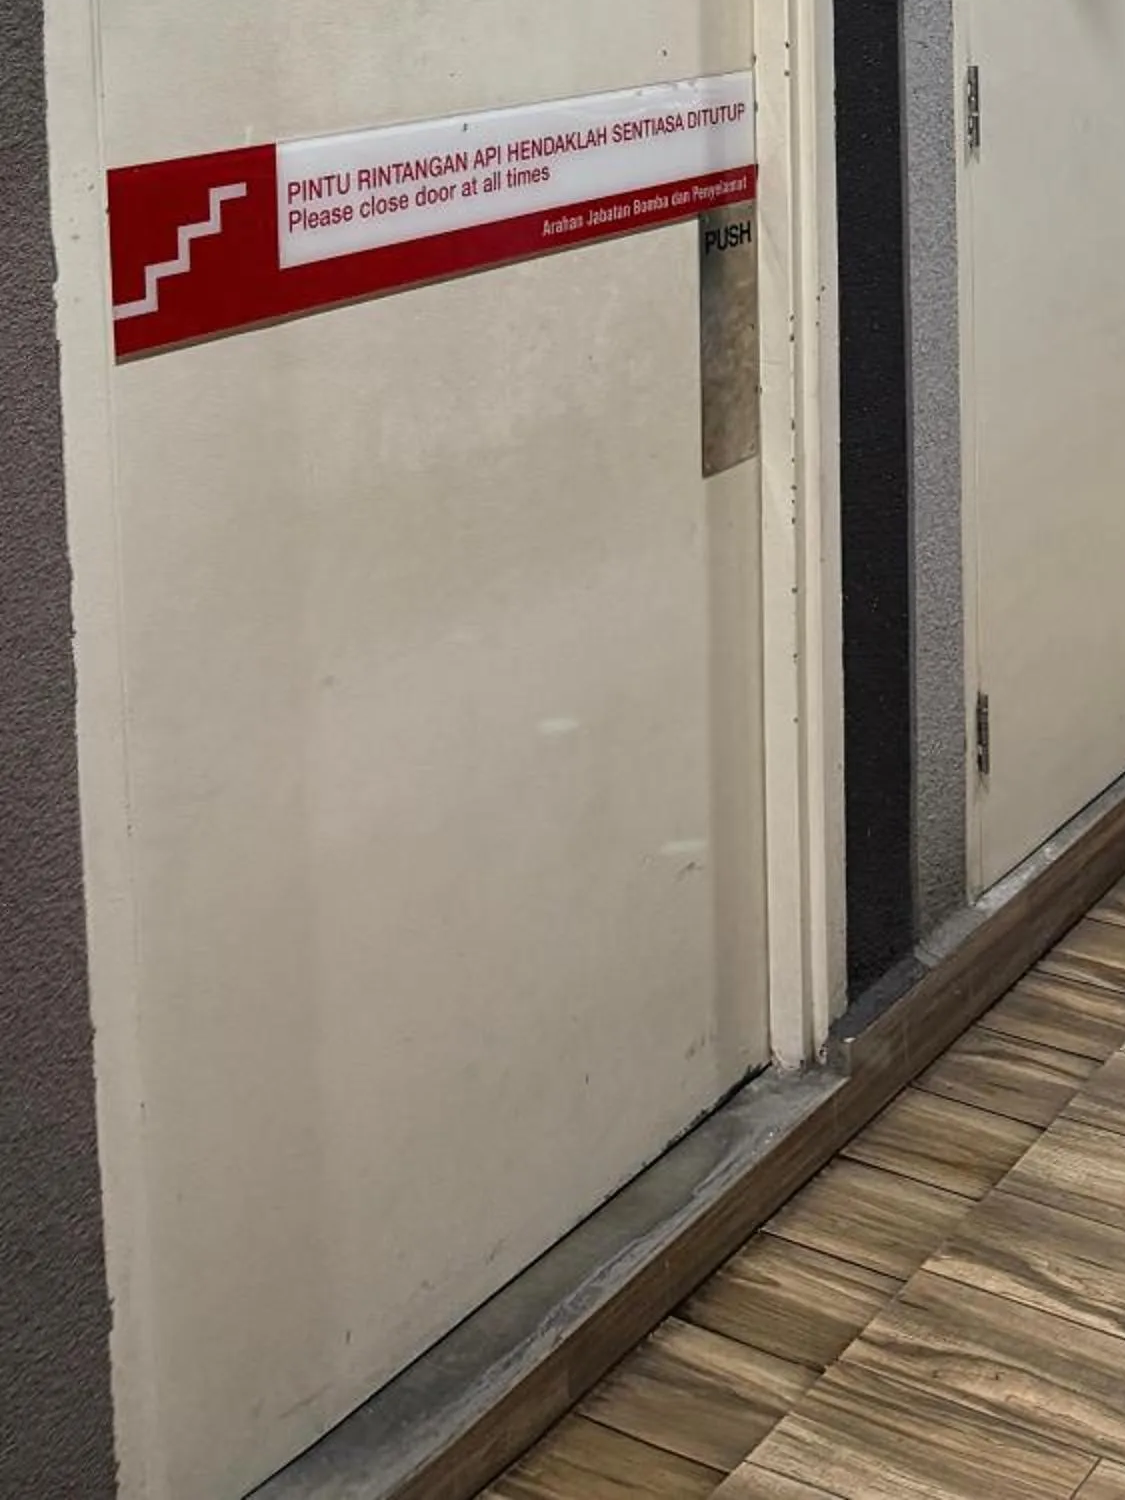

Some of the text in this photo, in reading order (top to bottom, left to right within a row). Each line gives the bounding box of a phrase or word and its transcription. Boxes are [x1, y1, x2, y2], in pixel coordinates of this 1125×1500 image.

[287, 103, 746, 205] PINTU RINTANGAN API HENDAKLAH SENTIASA DITUTUP
[288, 165, 551, 233] Please close door at all times
[541, 214, 585, 237] Arahan
[586, 204, 632, 227] Jabatan
[704, 220, 753, 256] PUSH
